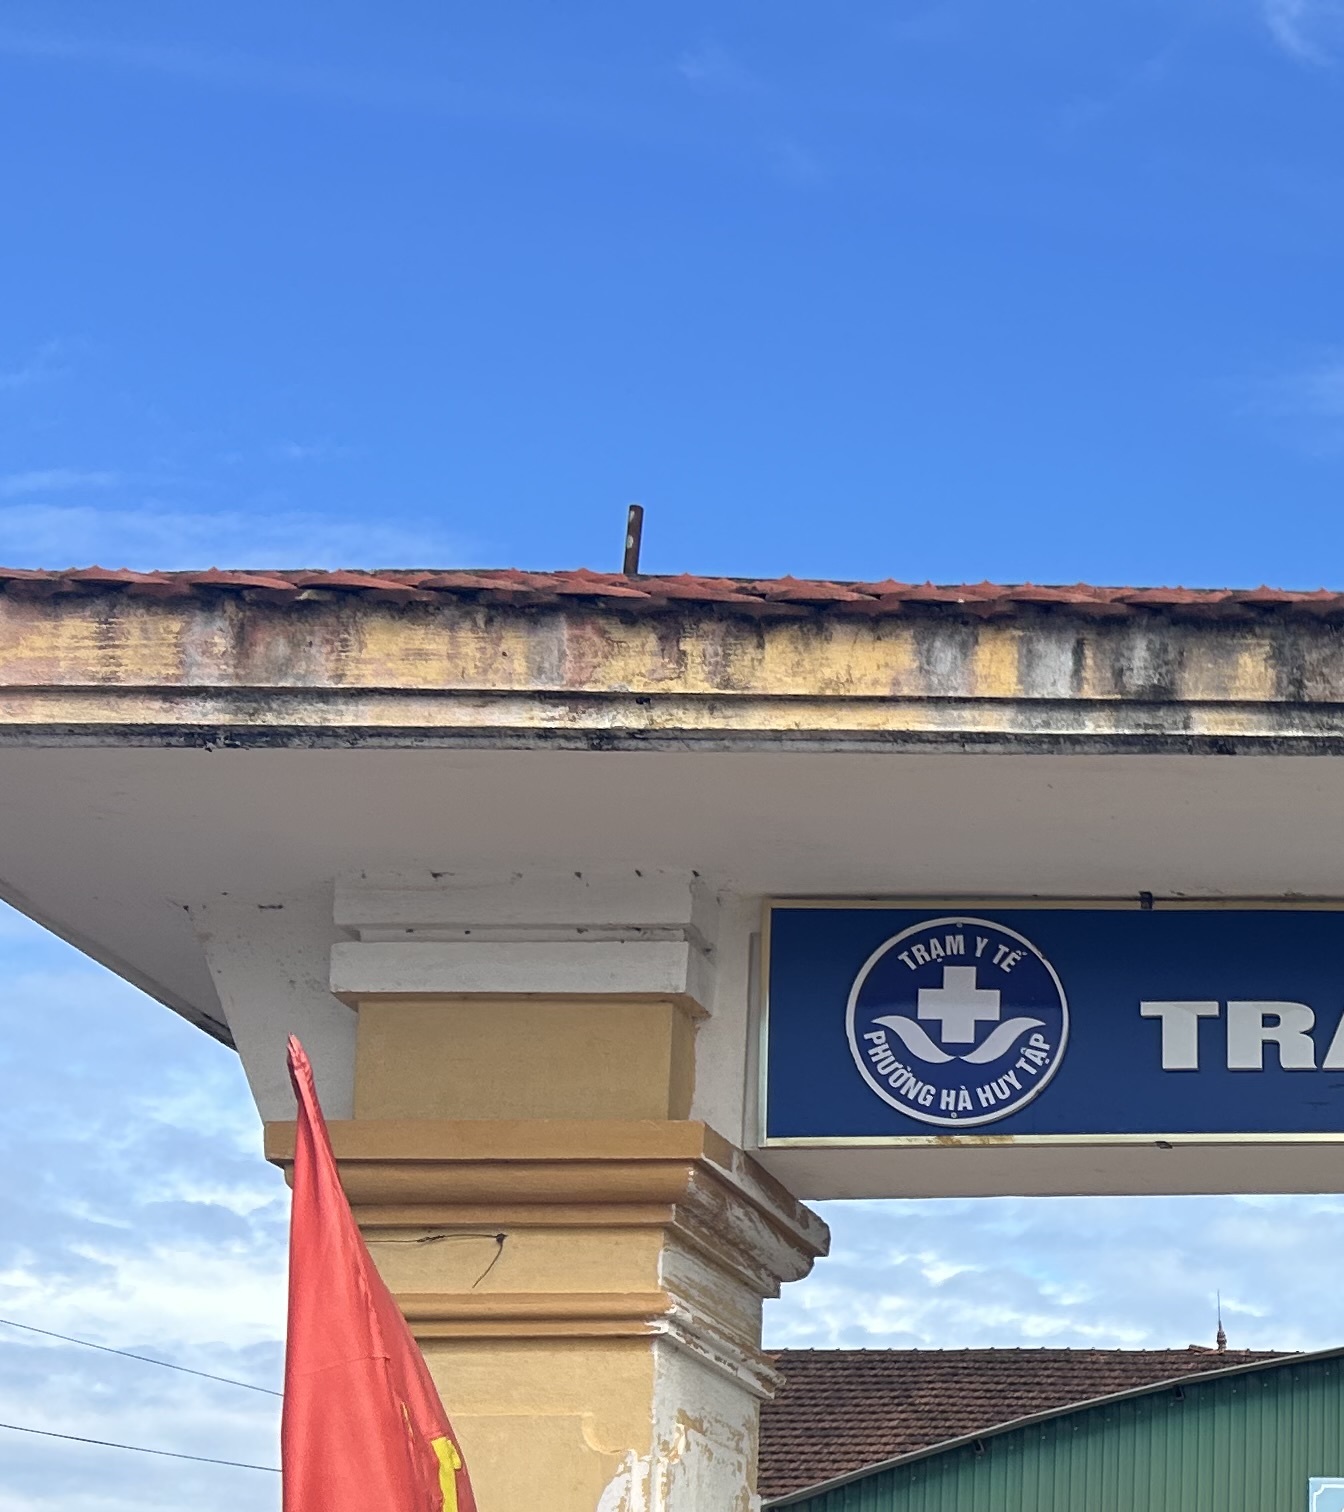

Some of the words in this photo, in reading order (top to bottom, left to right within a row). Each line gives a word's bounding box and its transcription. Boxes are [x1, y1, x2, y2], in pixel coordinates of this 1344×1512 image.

[898, 935, 965, 971] TRẠM
[976, 936, 988, 958] Y
[992, 944, 1029, 974] TẾ
[863, 1030, 937, 1107] PHƯỜNG
[940, 1085, 973, 1111] HÀ
[976, 1070, 1023, 1108] HUY
[1015, 1032, 1052, 1076] TẬP
